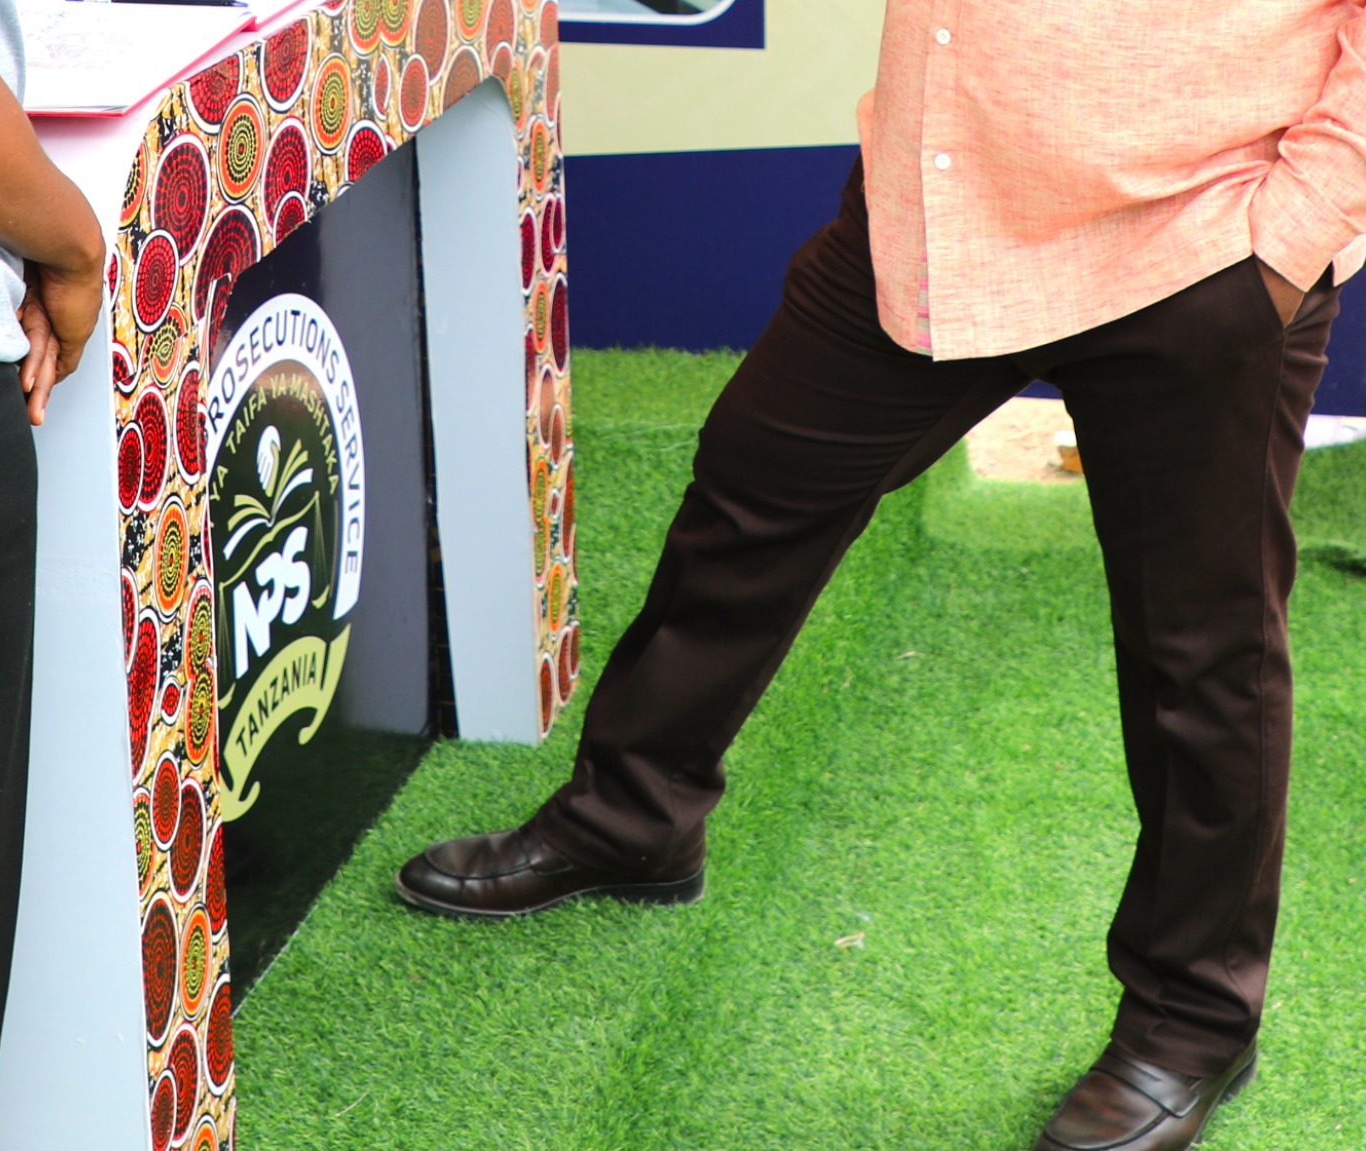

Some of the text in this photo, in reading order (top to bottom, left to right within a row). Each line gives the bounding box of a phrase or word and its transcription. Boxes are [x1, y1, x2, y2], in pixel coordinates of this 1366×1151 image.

[208, 309, 360, 575] ROSECUTIONS SERVICE
[225, 386, 268, 455] TAIFA
[270, 372, 286, 399] YA
[289, 372, 339, 495] MASHTAKA
[233, 525, 311, 680] NPS
[235, 651, 317, 757] TANZANIA
